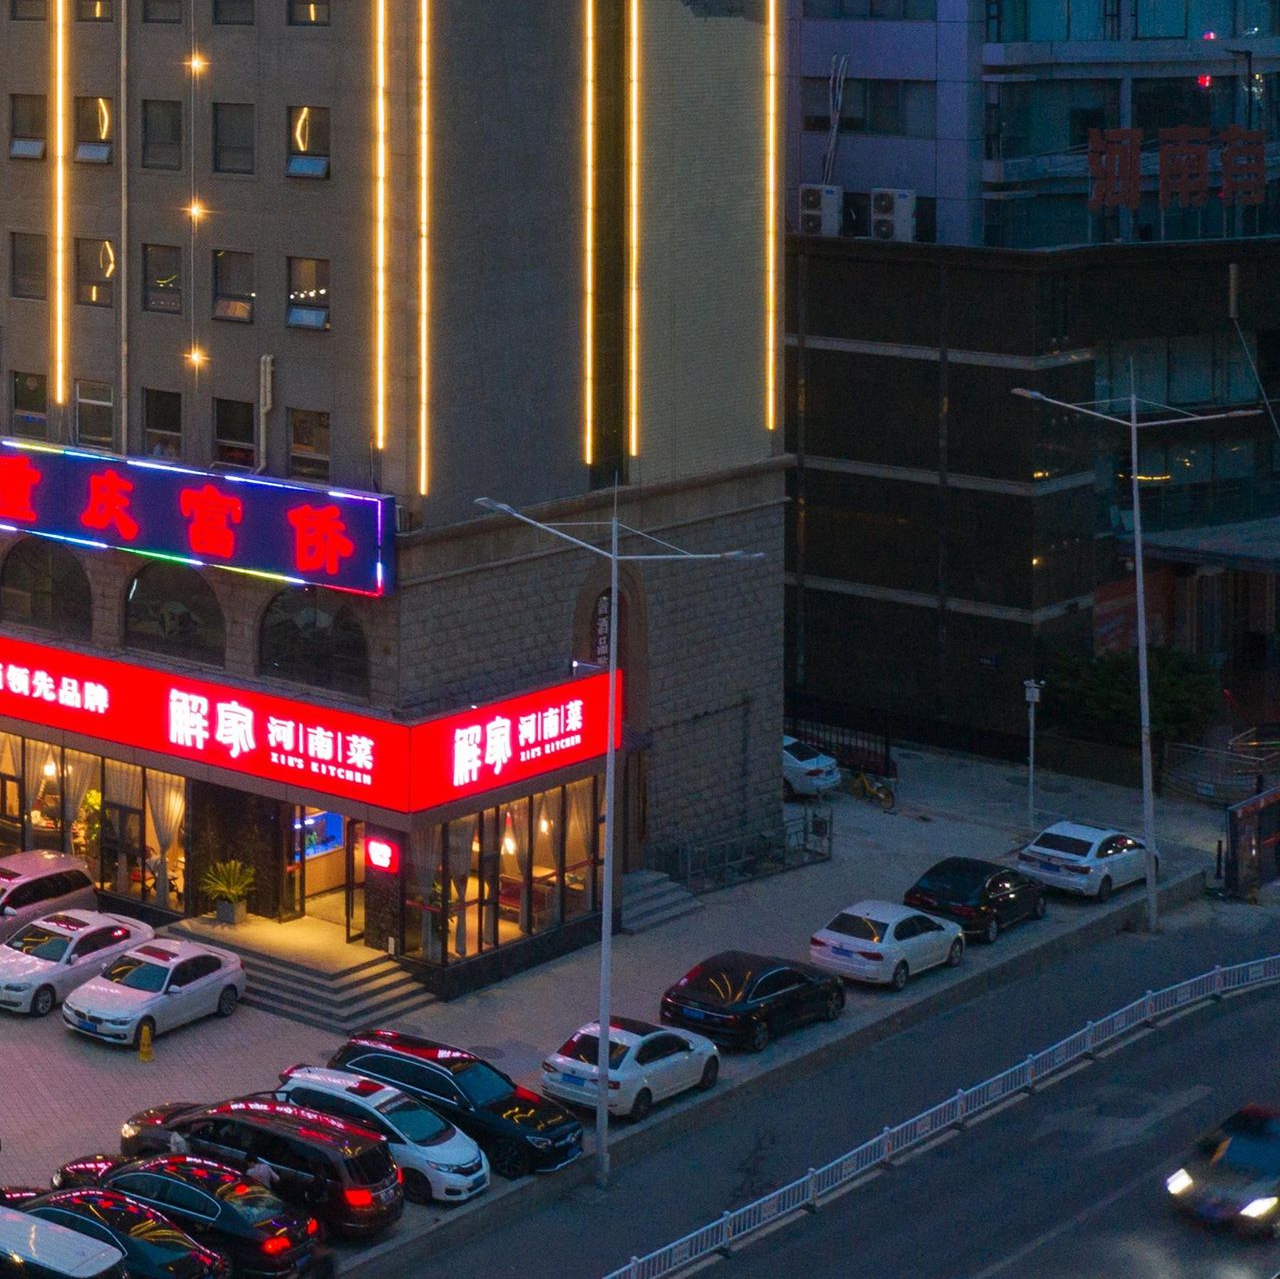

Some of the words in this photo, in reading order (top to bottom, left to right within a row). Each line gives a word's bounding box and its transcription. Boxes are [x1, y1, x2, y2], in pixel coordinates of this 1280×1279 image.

[169, 688, 256, 759] 解家
[544, 734, 582, 755] KITCHEN
[311, 762, 373, 786] KITCHEN
[452, 715, 512, 788] 解家
